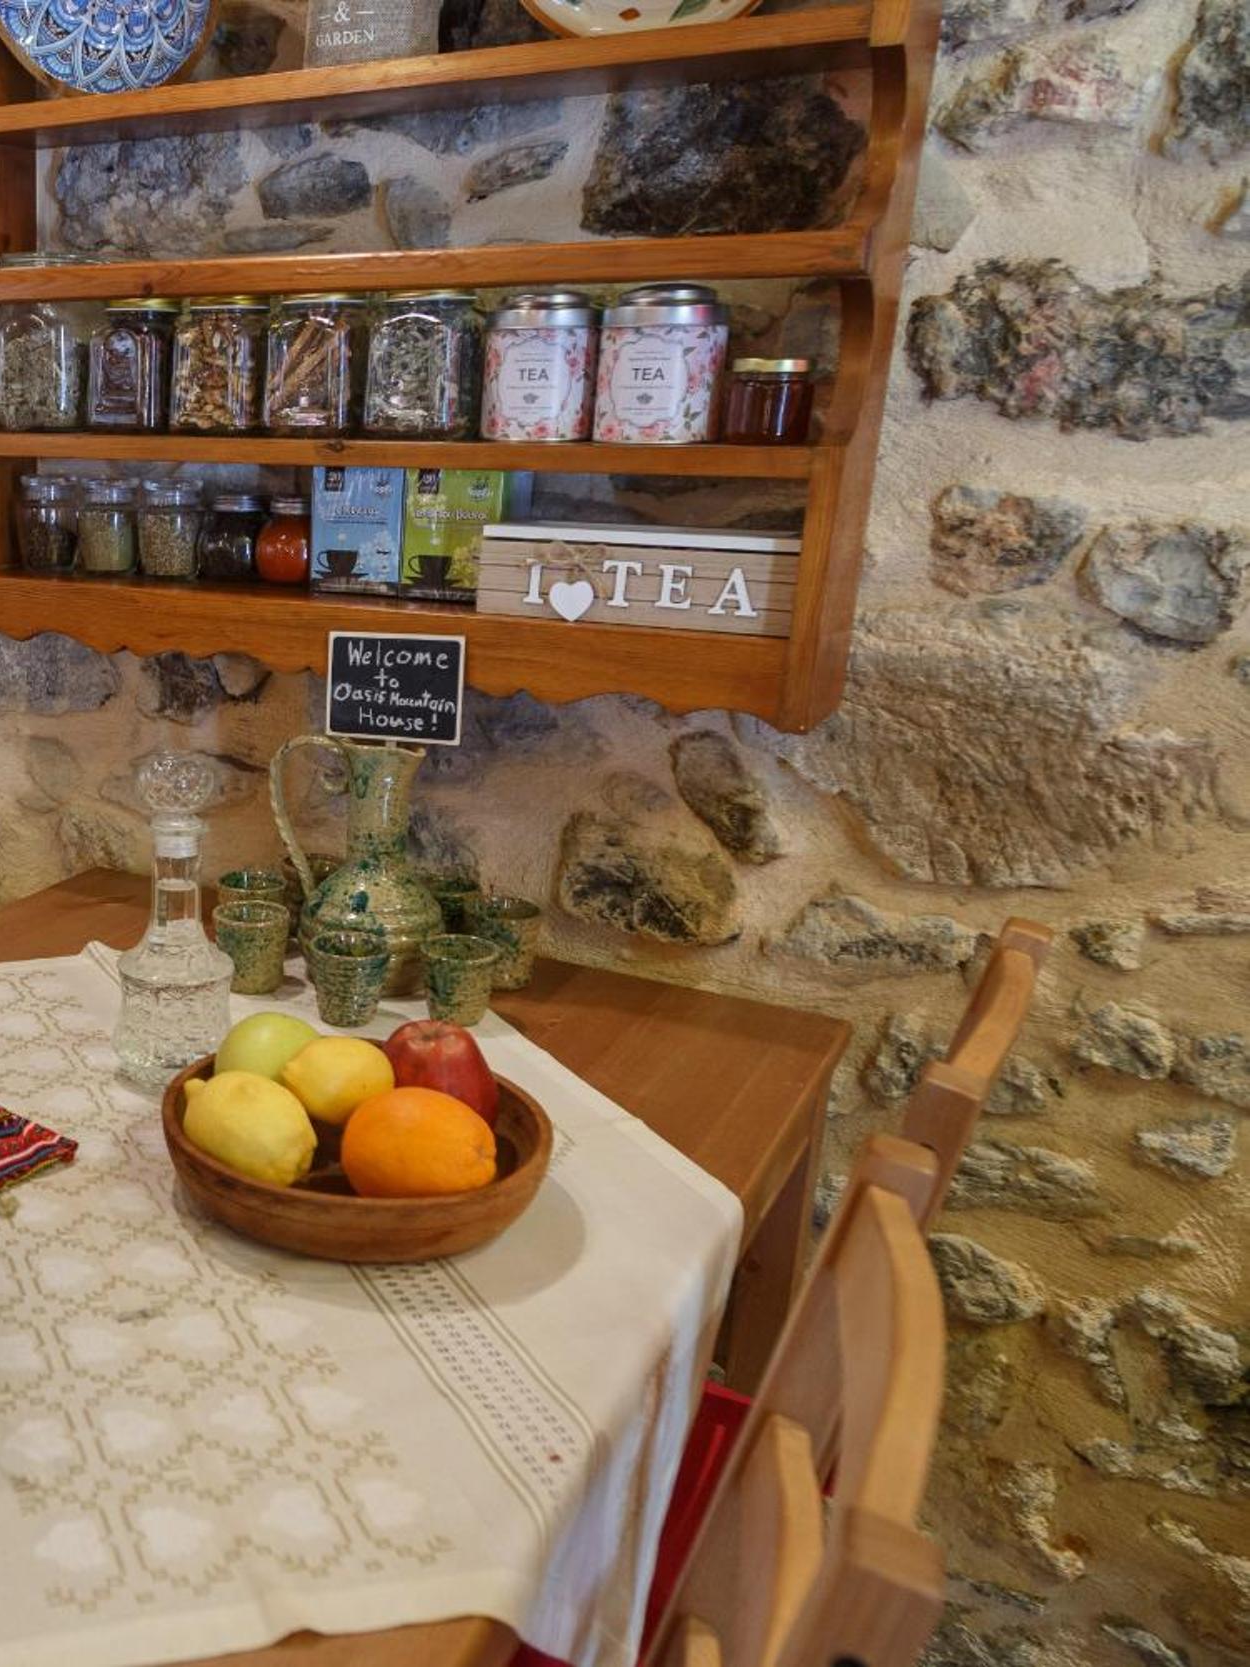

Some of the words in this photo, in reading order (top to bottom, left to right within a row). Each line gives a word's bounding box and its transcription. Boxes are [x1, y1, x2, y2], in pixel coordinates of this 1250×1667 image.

[315, 23, 375, 47] GARDEN
[518, 368, 549, 381] TEA
[632, 367, 665, 381] TEA
[603, 559, 758, 617] TEA
[348, 640, 449, 669] Welcome
[374, 668, 399, 688] to
[389, 689, 456, 714] Mountain
